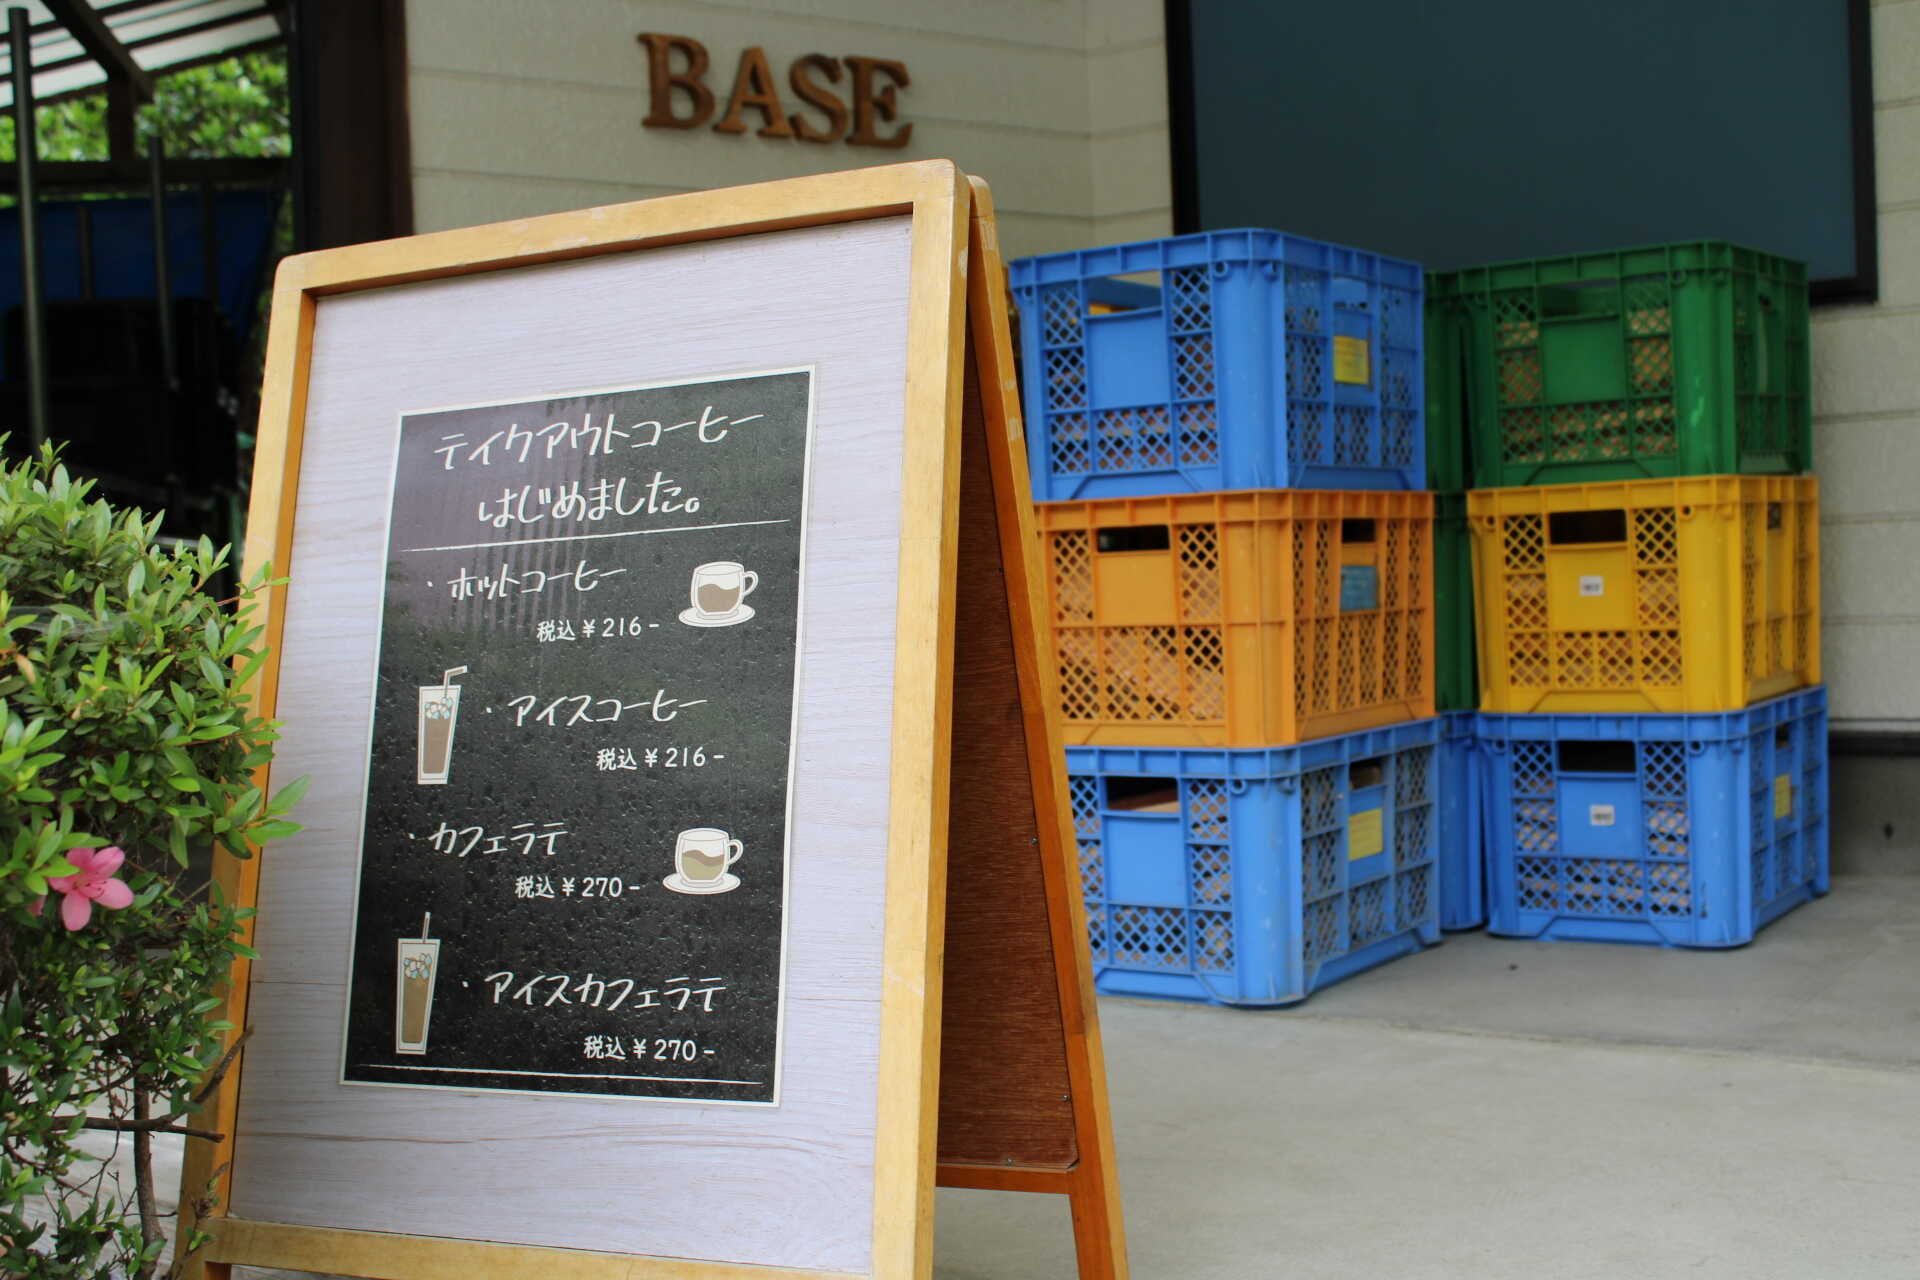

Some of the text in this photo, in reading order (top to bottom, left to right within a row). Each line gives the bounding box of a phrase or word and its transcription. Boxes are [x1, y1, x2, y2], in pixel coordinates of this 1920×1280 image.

[637, 33, 913, 148] BASE
[434, 405, 764, 470] テイクアウトコーヒー
[478, 471, 700, 528] はじめました。
[447, 559, 627, 601] ホットコーヒー
[507, 689, 708, 727] アイスコーヒー
[428, 822, 568, 857] カフェラテ
[485, 971, 726, 1012] アイスカフェラテ
